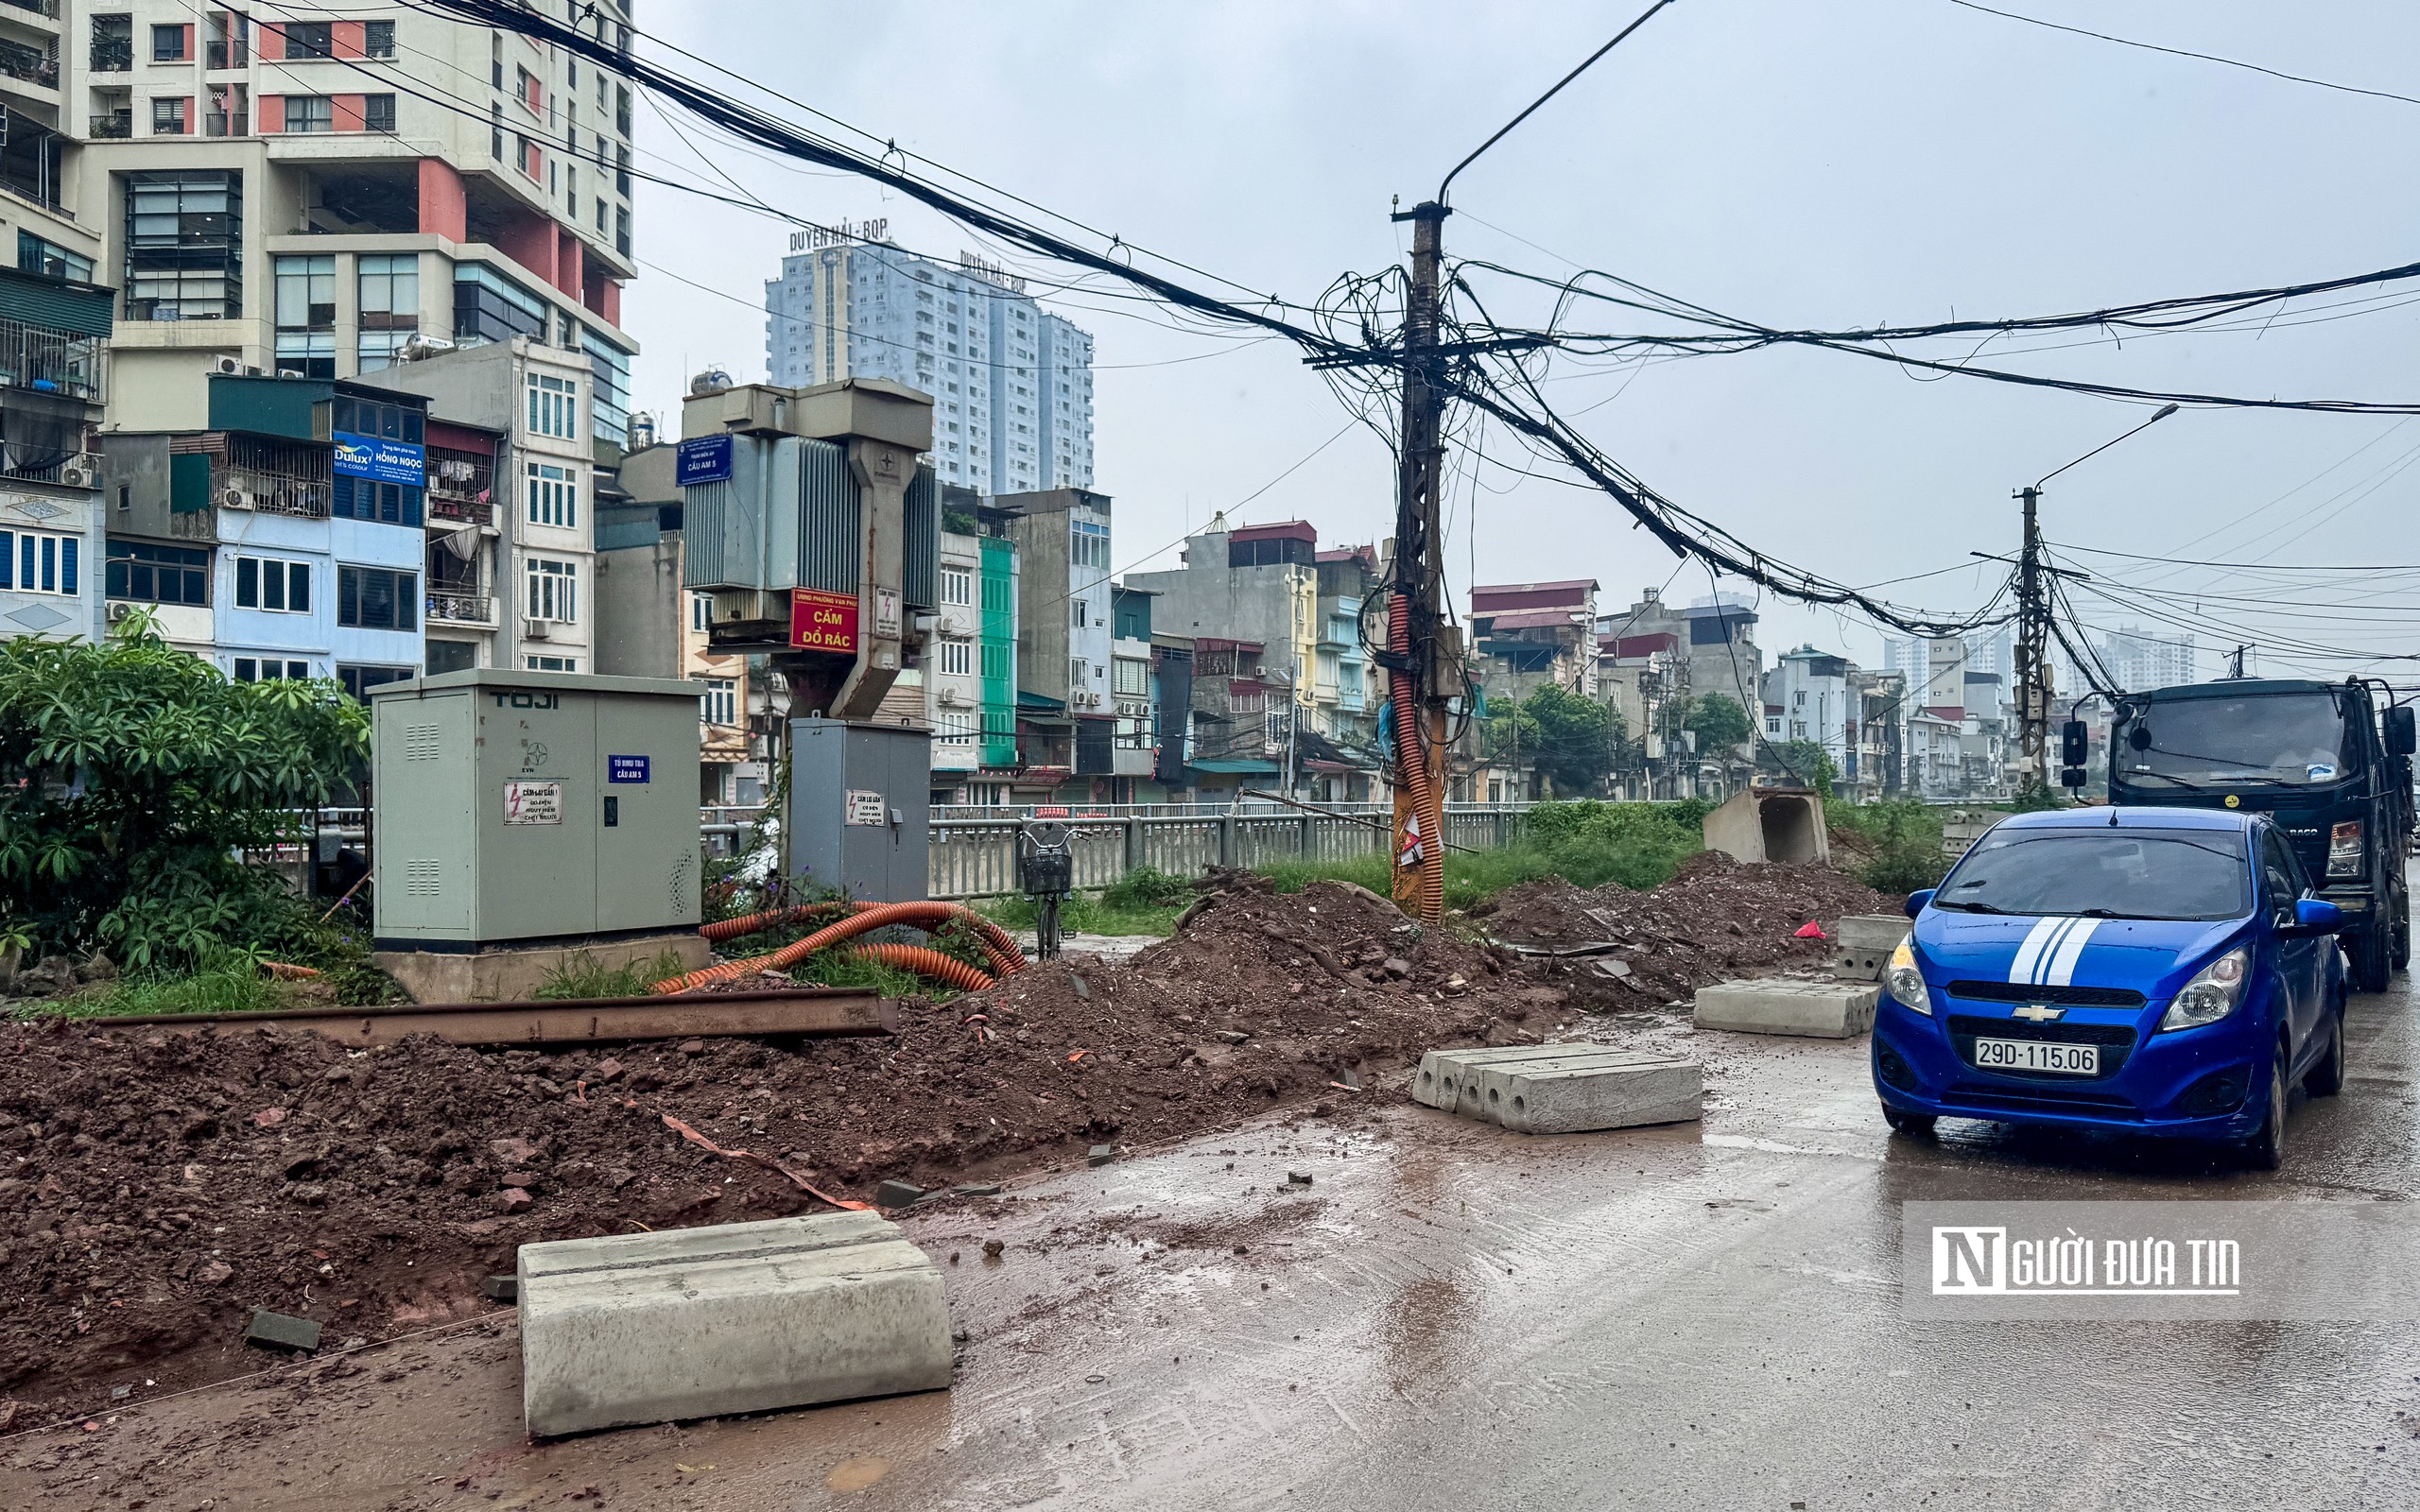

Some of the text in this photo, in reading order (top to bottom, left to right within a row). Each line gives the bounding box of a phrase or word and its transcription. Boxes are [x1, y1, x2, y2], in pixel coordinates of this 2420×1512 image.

[832, 216, 853, 245] HẢI
[863, 218, 888, 240] BQP
[334, 449, 369, 465] Dulux
[399, 456, 423, 470] NGỌC
[348, 462, 369, 472] colour
[814, 609, 842, 626] CẤM
[825, 631, 851, 647] RÁC
[490, 691, 559, 710] TOJI
[1979, 1042, 2094, 1071] 29D-115.06
